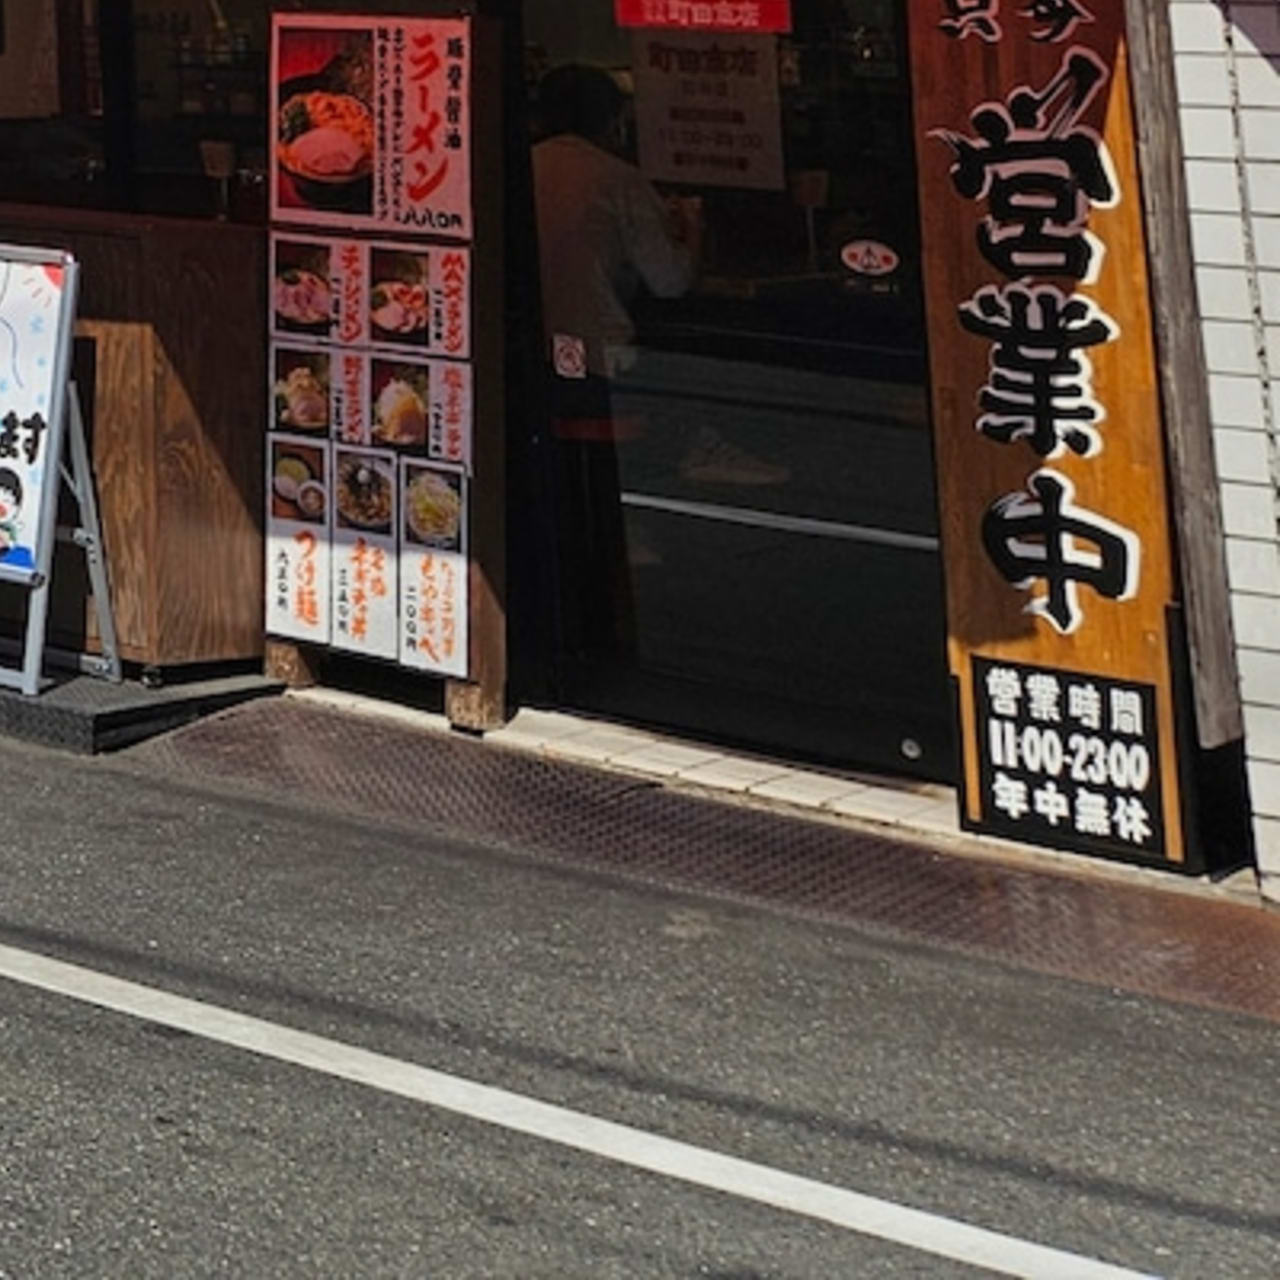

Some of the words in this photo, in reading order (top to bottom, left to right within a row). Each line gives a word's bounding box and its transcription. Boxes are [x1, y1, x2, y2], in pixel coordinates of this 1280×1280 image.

[404, 31, 450, 204] ラーメン
[929, 46, 1140, 635] 営業中
[985, 667, 1144, 736] 営業時間
[992, 773, 1153, 846] 年中無休
